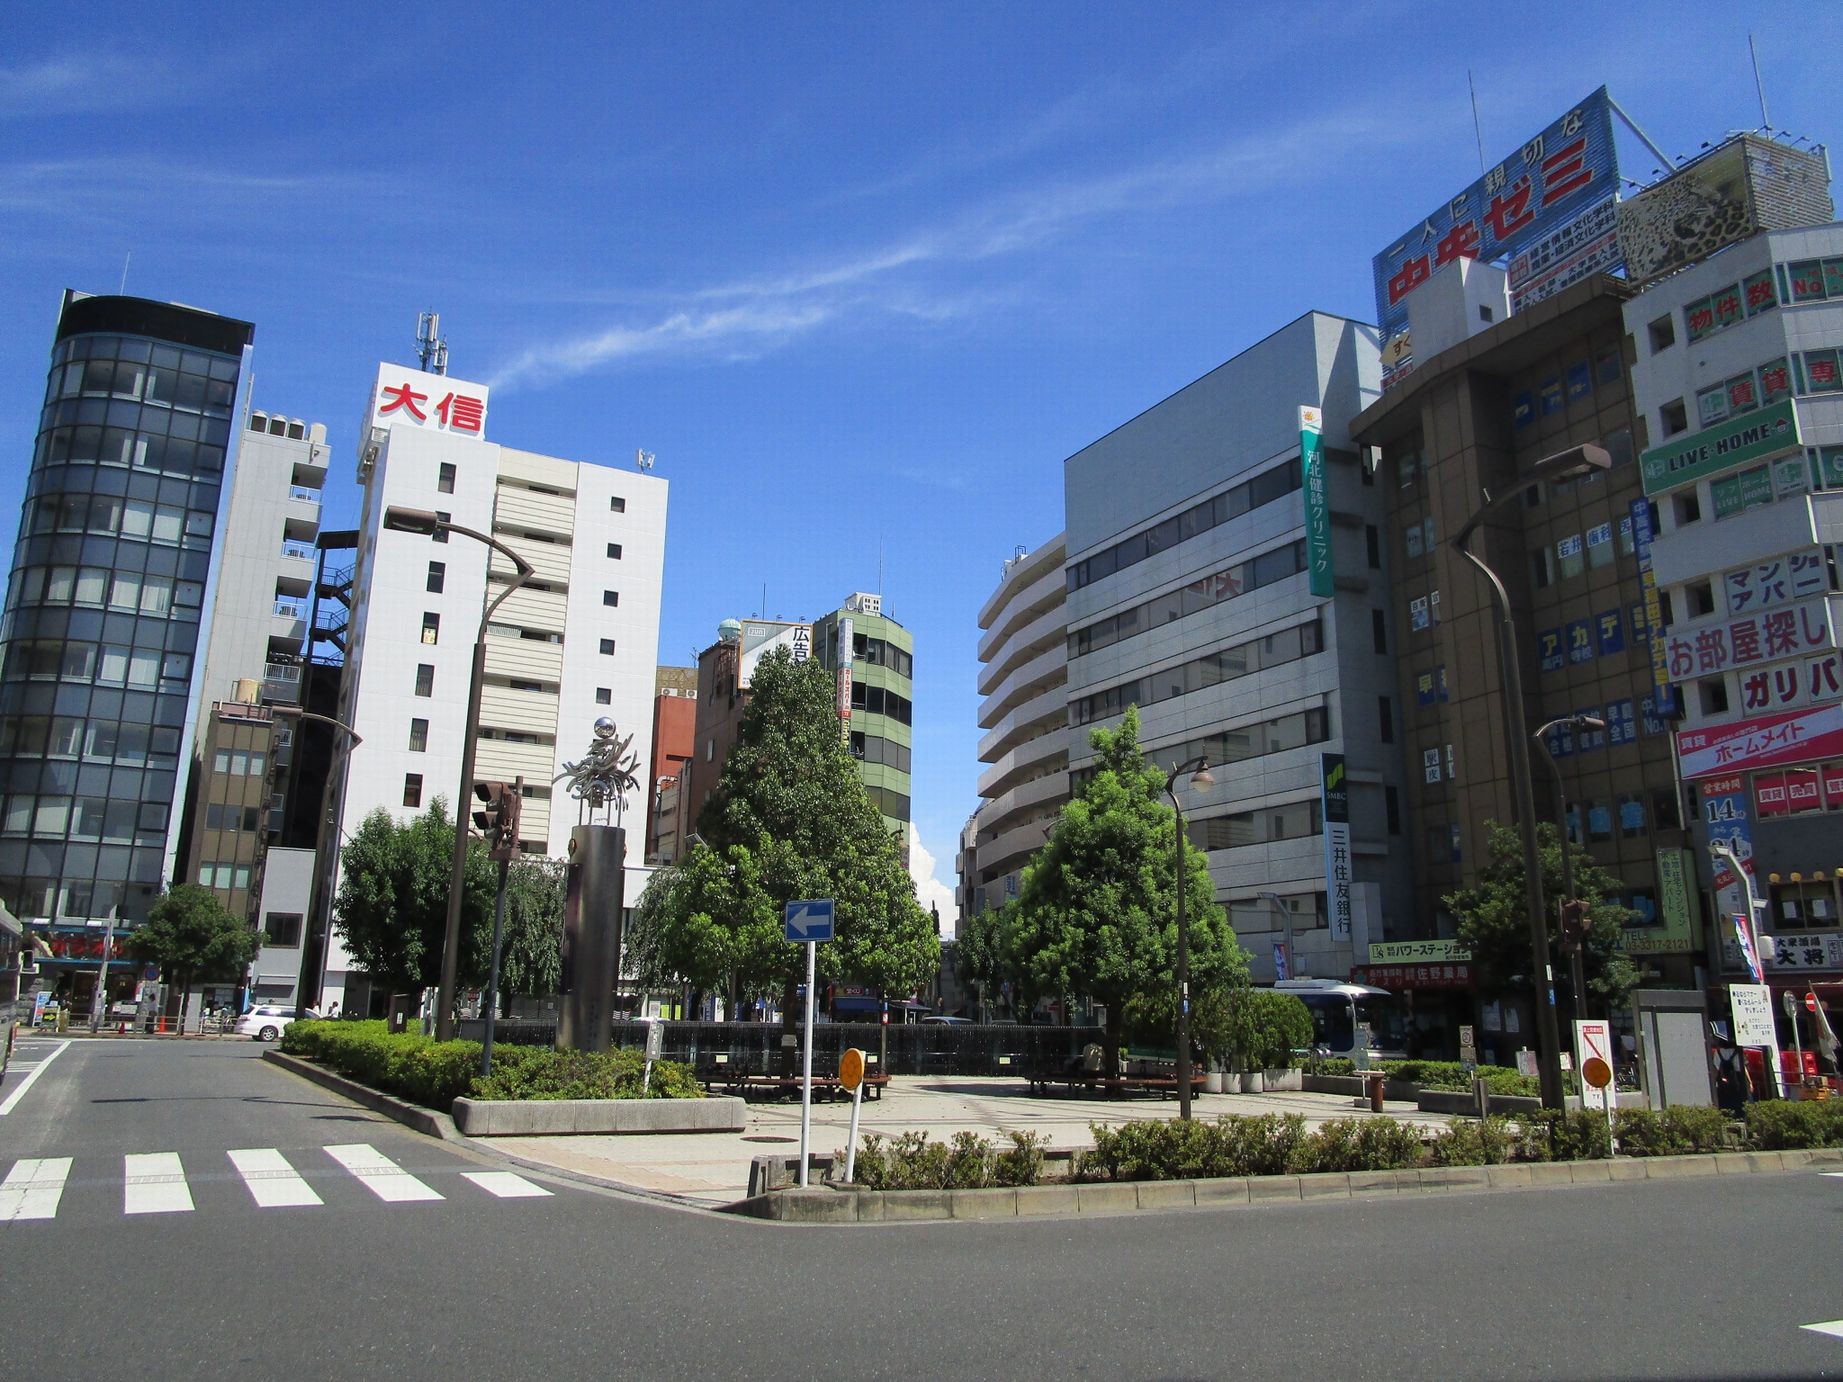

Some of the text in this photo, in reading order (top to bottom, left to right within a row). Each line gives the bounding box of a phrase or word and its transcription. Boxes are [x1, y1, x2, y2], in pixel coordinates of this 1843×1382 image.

[1388, 109, 1584, 257] 一人に親切な
[1388, 137, 1593, 305] 中央ゼミ
[1689, 280, 1775, 331] 物件数
[379, 382, 484, 434] 大信
[1669, 423, 1771, 472] LIVE HOME
[1307, 449, 1327, 574] 河北健診クリニック
[1668, 606, 1826, 678] お部屋探し
[1680, 734, 1707, 750] 賃貸
[1715, 722, 1806, 764] ホームメイト
[1326, 791, 1347, 801] SMBC
[1332, 829, 1351, 935] 三井住友銀行
[1396, 944, 1470, 956] パワーステーション
[1776, 948, 1825, 966] 大将
